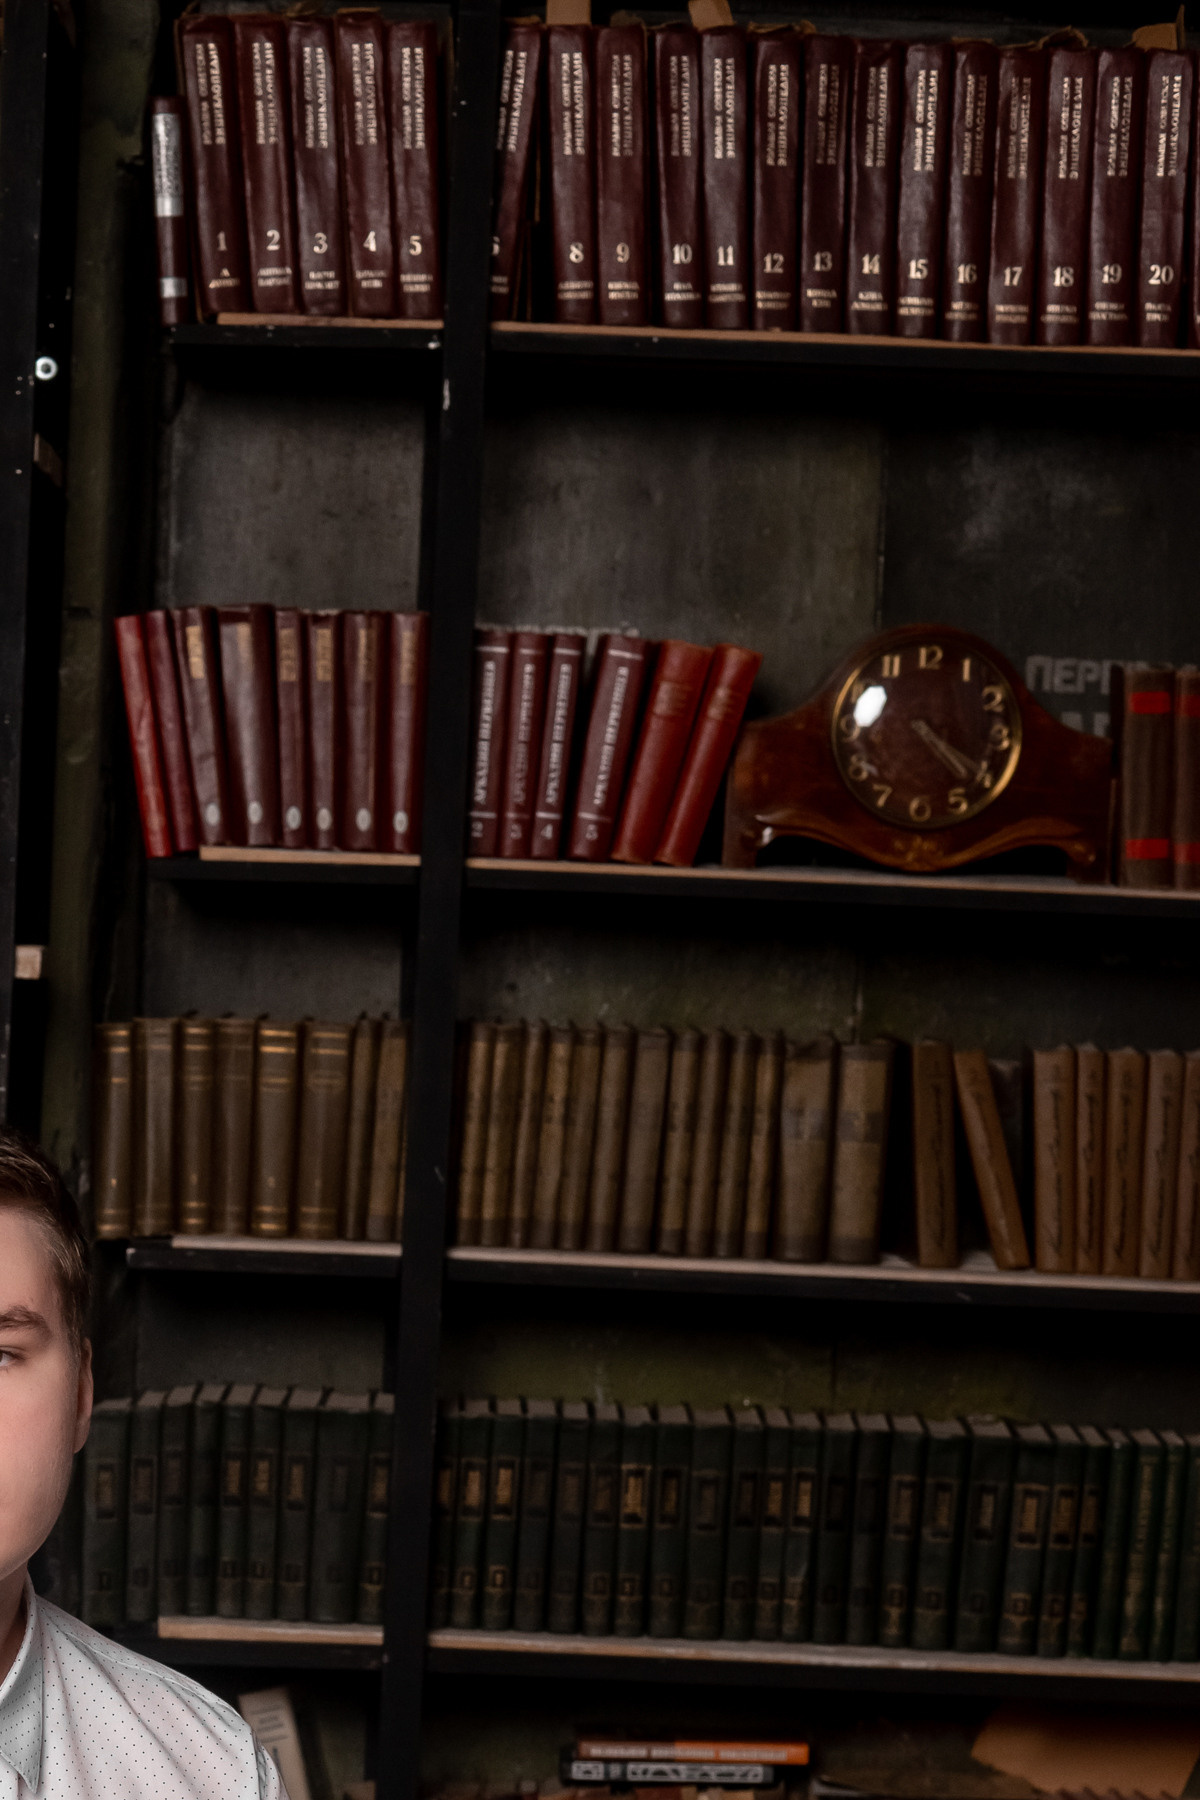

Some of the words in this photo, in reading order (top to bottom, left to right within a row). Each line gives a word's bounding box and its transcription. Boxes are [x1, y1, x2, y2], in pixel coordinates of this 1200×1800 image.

[217, 232, 227, 251] 1
[267, 230, 280, 251] 2
[314, 233, 328, 254] 3
[363, 230, 376, 251] 4
[409, 235, 422, 256] 5
[569, 243, 583, 263] 8
[616, 243, 630, 263] 9
[673, 245, 692, 265] 10
[717, 246, 734, 266] 11
[764, 253, 783, 273] 12
[814, 252, 832, 271] 13
[862, 254, 880, 274] 14
[909, 259, 927, 279] 15
[957, 264, 976, 283] 16
[1102, 264, 1122, 283] 19
[1004, 267, 1022, 286] 17
[1053, 267, 1073, 287] 18
[1149, 265, 1173, 284] 20
[919, 645, 943, 670] 12
[962, 658, 971, 682] 1
[981, 685, 1005, 713] 2
[990, 724, 1010, 751] 3
[873, 783, 892, 808] 7
[948, 787, 968, 813] 5
[909, 797, 932, 822] 6
[472, 822, 483, 837] 2
[541, 824, 552, 839] 4
